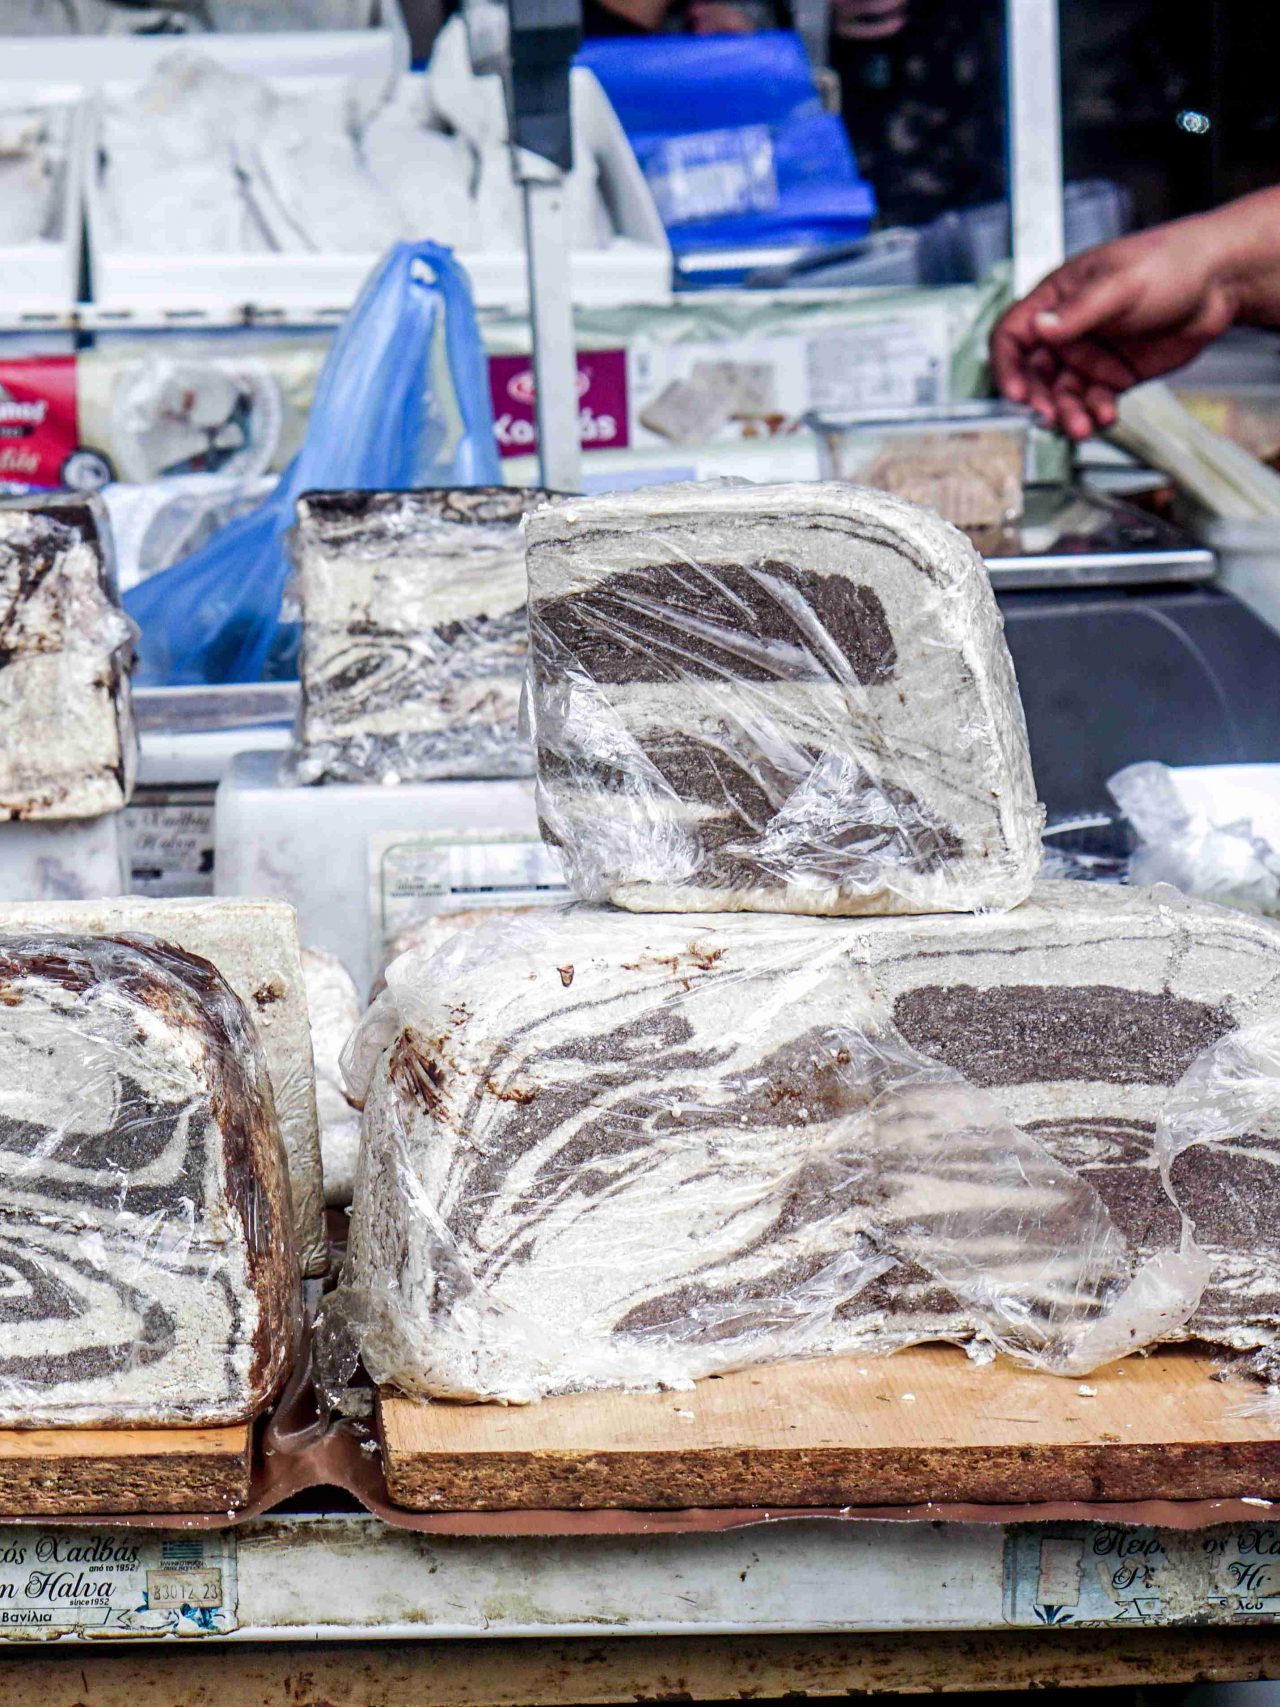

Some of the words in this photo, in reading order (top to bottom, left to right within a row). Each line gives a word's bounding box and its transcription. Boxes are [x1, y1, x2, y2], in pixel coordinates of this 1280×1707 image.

[36, 1535, 140, 1565] Χαλβάς
[116, 1564, 136, 1572] 1952
[25, 1571, 116, 1601] Halva
[2, 1611, 52, 1623] Βανίλια
